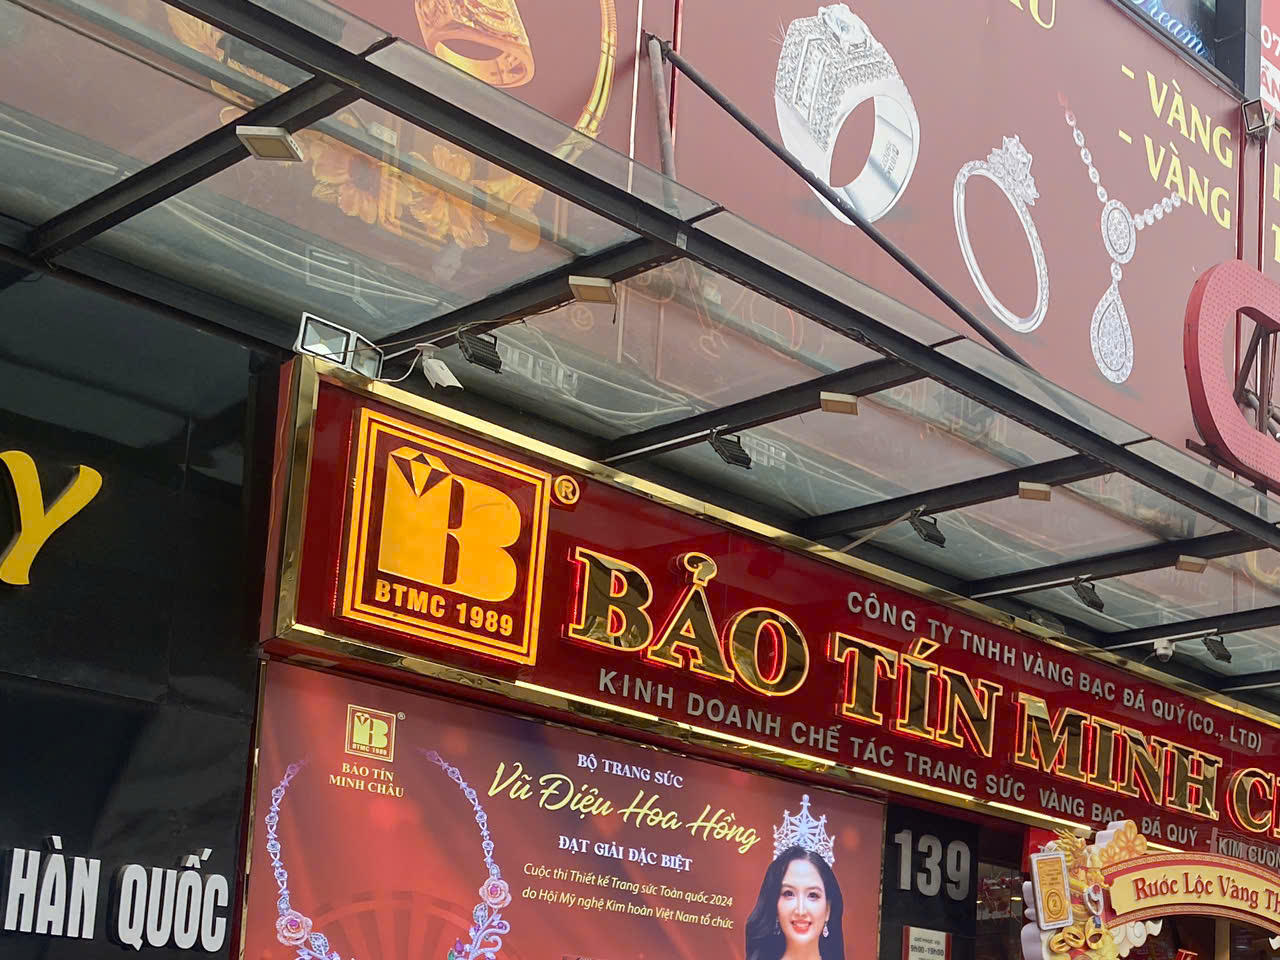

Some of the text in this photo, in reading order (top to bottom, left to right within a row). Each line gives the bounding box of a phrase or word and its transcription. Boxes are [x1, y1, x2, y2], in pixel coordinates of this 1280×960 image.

[1146, 70, 1233, 168] VÀNG
[1144, 133, 1232, 231] VÀNG
[374, 578, 514, 636] BTMC 1989
[567, 546, 811, 697] BẢO
[830, 632, 1003, 758] TÍN
[1015, 692, 1223, 821] MINH
[847, 591, 917, 633] CÔNG
[928, 618, 955, 645] TY
[960, 629, 1016, 667] TNHH
[1022, 651, 1075, 688] VÀNG
[1079, 672, 1116, 701] BẠC
[1123, 688, 1146, 713] ĐÁ
[1229, 726, 1264, 753] LTD)
[328, 774, 404, 798] MINH CHÂU
[341, 762, 395, 782] BẢO TÍN
[577, 753, 684, 789] BỘ TRANG SỨC
[599, 668, 675, 710] KINH
[687, 692, 782, 738] DOANH
[791, 720, 843, 753] CHẾ
[849, 737, 895, 768] TÁC
[903, 752, 978, 790] TRANG
[985, 771, 1026, 802] SỨC
[1039, 786, 1085, 818] VÀNG
[1141, 816, 1162, 839] ĐÁ
[1167, 824, 1198, 847] QUÝ
[1218, 838, 1243, 859] KIM
[487, 762, 761, 854] Vũ Điệu Hoa Hồng
[523, 863, 733, 907] Cuộc thi Thiết kế Trang sức Toàn quốc 2024
[558, 835, 693, 872] ĐẠT GIẢI ĐẶC BIỆT
[894, 828, 971, 900] 139
[3, 835, 230, 953] HÀN QUỐC
[522, 887, 537, 900] do
[538, 888, 558, 903] Hội
[559, 892, 576, 908] Mỹ
[577, 896, 605, 911] nghệ
[605, 899, 625, 913] Kim
[627, 902, 653, 917] hoàn
[655, 907, 674, 921] Việt
[675, 910, 698, 924] Nam
[711, 916, 734, 929] chức
[1132, 874, 1178, 901] Rước
[1183, 872, 1213, 898] Lộc
[1217, 875, 1259, 908] Vàng
